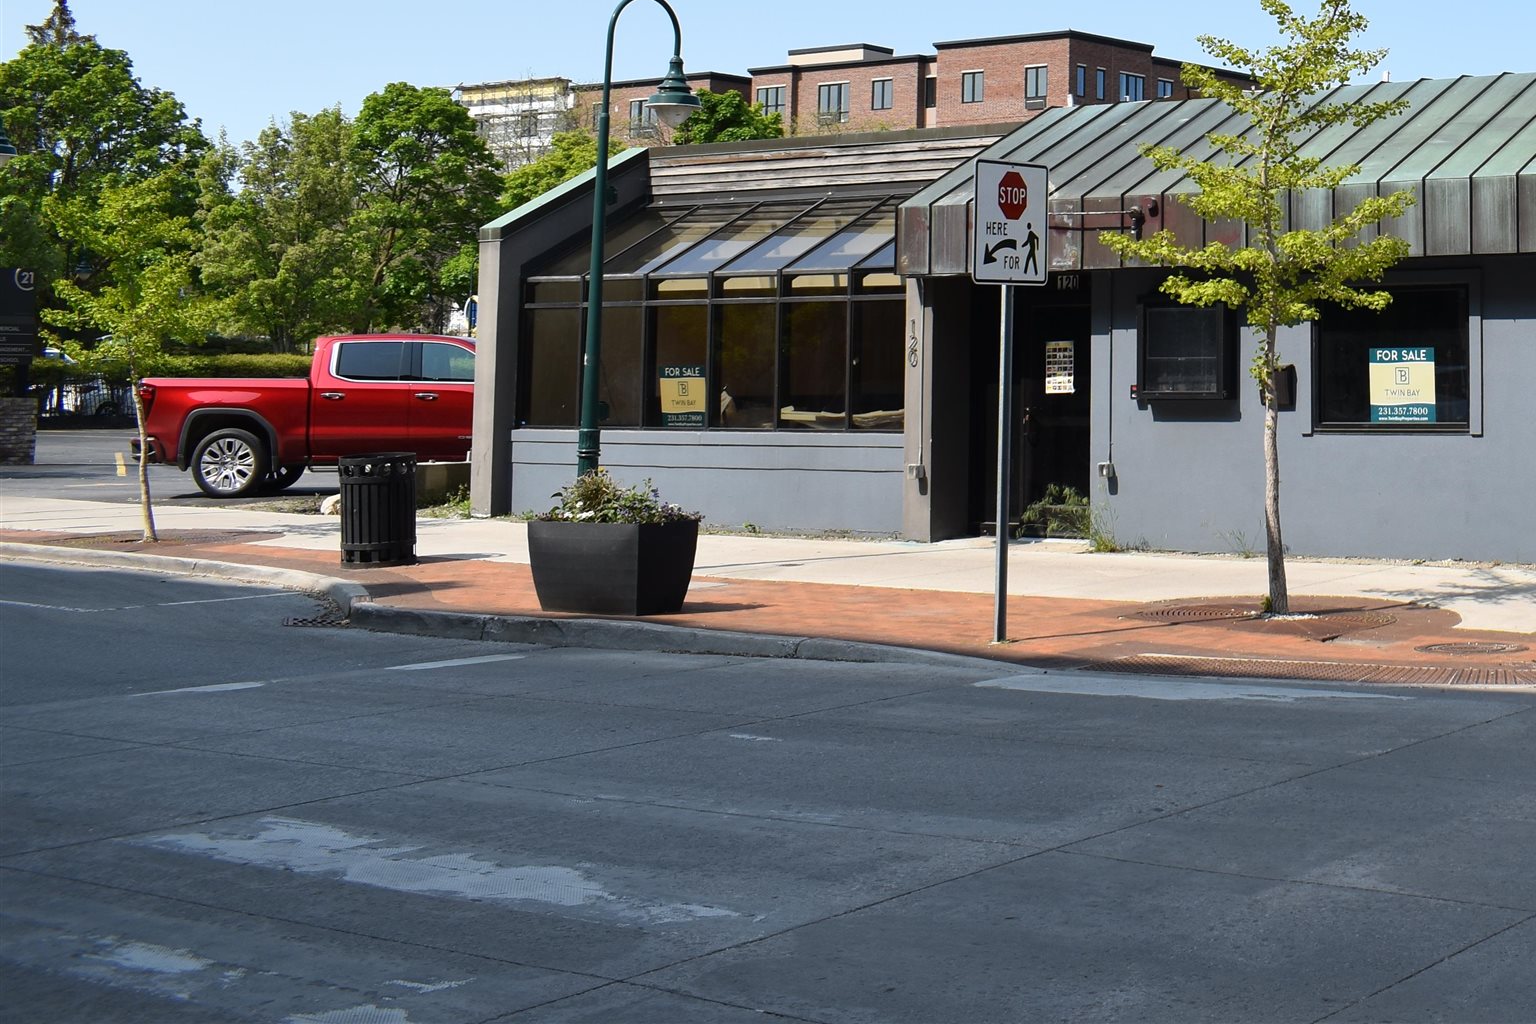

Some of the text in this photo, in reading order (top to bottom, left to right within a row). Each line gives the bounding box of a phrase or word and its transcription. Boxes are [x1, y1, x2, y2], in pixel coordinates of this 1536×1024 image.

[1000, 187, 1026, 205] STOP
[986, 222, 1008, 236] HERE
[1003, 256, 1020, 270] FOR
[1058, 276, 1078, 290] 120
[1376, 349, 1427, 361] FOR SALE
[665, 367, 700, 376] FOR SALE
[1384, 388, 1421, 397] TWIN BAY
[1378, 406, 1429, 415] 231.357.7800
